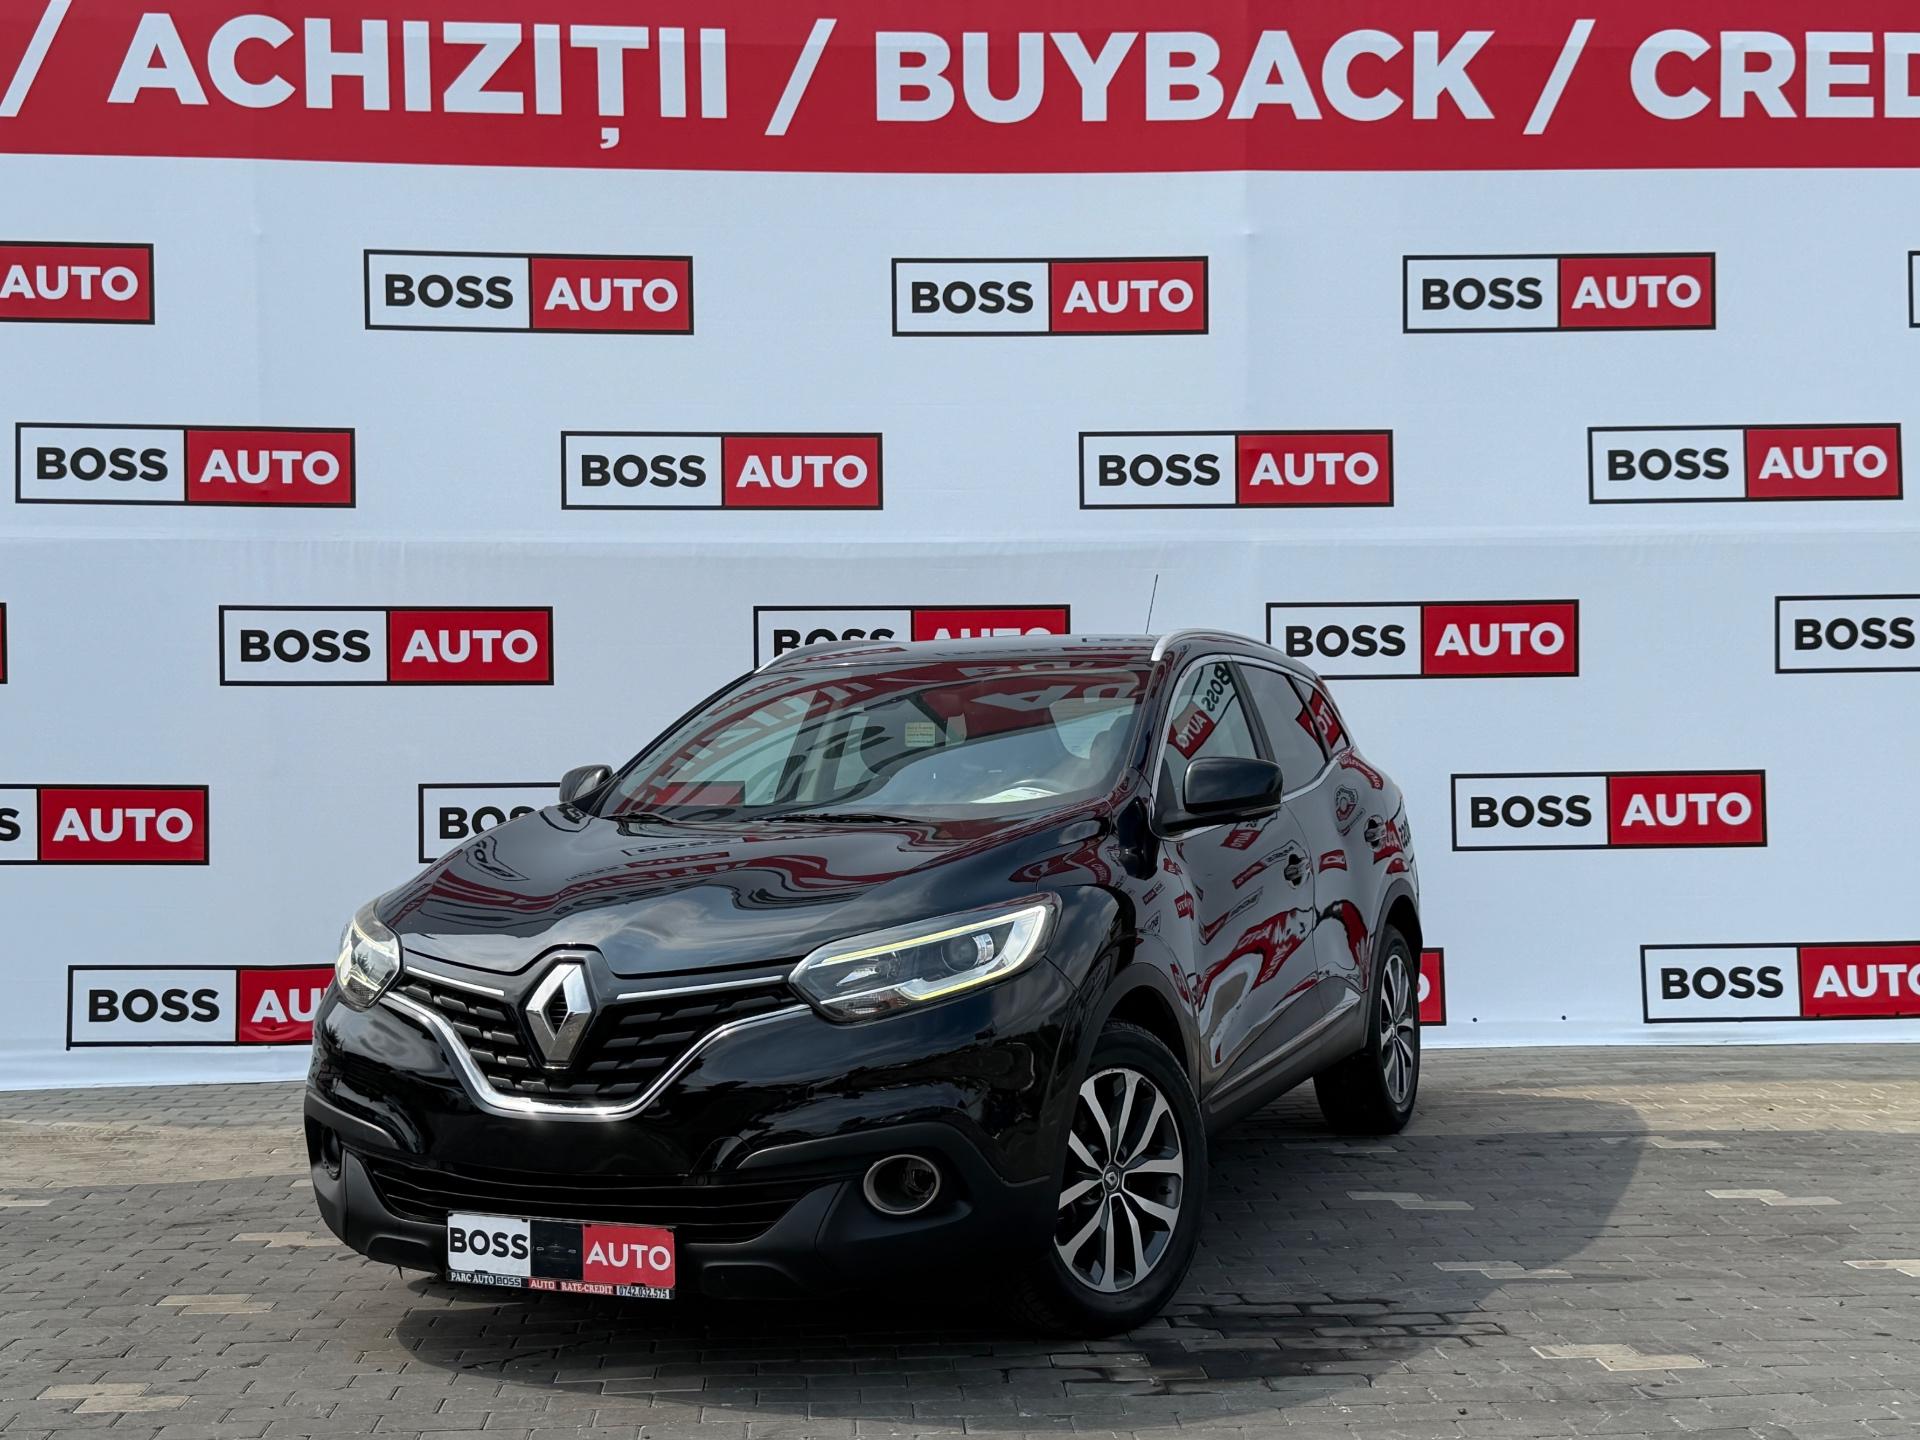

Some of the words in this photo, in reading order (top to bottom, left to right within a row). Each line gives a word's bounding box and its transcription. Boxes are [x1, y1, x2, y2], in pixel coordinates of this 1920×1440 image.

[107, 13, 727, 149] ACHIZIȚII
[876, 29, 1494, 123] BUYBACK
[1, 265, 138, 301] AUTO
[386, 274, 513, 309] BOSS
[544, 277, 678, 312] AUTO
[912, 282, 1033, 313] BOSS
[1063, 279, 1193, 313] AUTO
[1423, 278, 1542, 310] BOSS
[1572, 275, 1701, 309] AUTO
[37, 447, 167, 481] BOSS
[200, 449, 339, 485] AUTO
[582, 455, 706, 487] BOSS
[736, 455, 867, 488] AUTO
[1099, 454, 1220, 486] BOSS
[1250, 452, 1378, 485] AUTO
[1608, 448, 1728, 480] BOSS
[1759, 446, 1887, 479] AUTO
[241, 630, 370, 662] BOSS
[402, 630, 537, 663] AUTO
[1286, 625, 1405, 657] BOSS
[1435, 622, 1564, 656] AUTO
[1795, 617, 1915, 650] BOSS
[53, 808, 193, 842] AUTO
[1471, 795, 1591, 828] BOSS
[1622, 792, 1751, 826] AUTO
[1661, 966, 1783, 999] BOSS
[89, 989, 219, 1022] BOSS
[449, 1227, 529, 1260] BOSS
[586, 1241, 671, 1271] AUTO
[451, 1271, 472, 1284] PARC
[473, 1274, 495, 1286] AUTO
[496, 1276, 521, 1287] BOSS
[531, 1280, 555, 1290] AUTO
